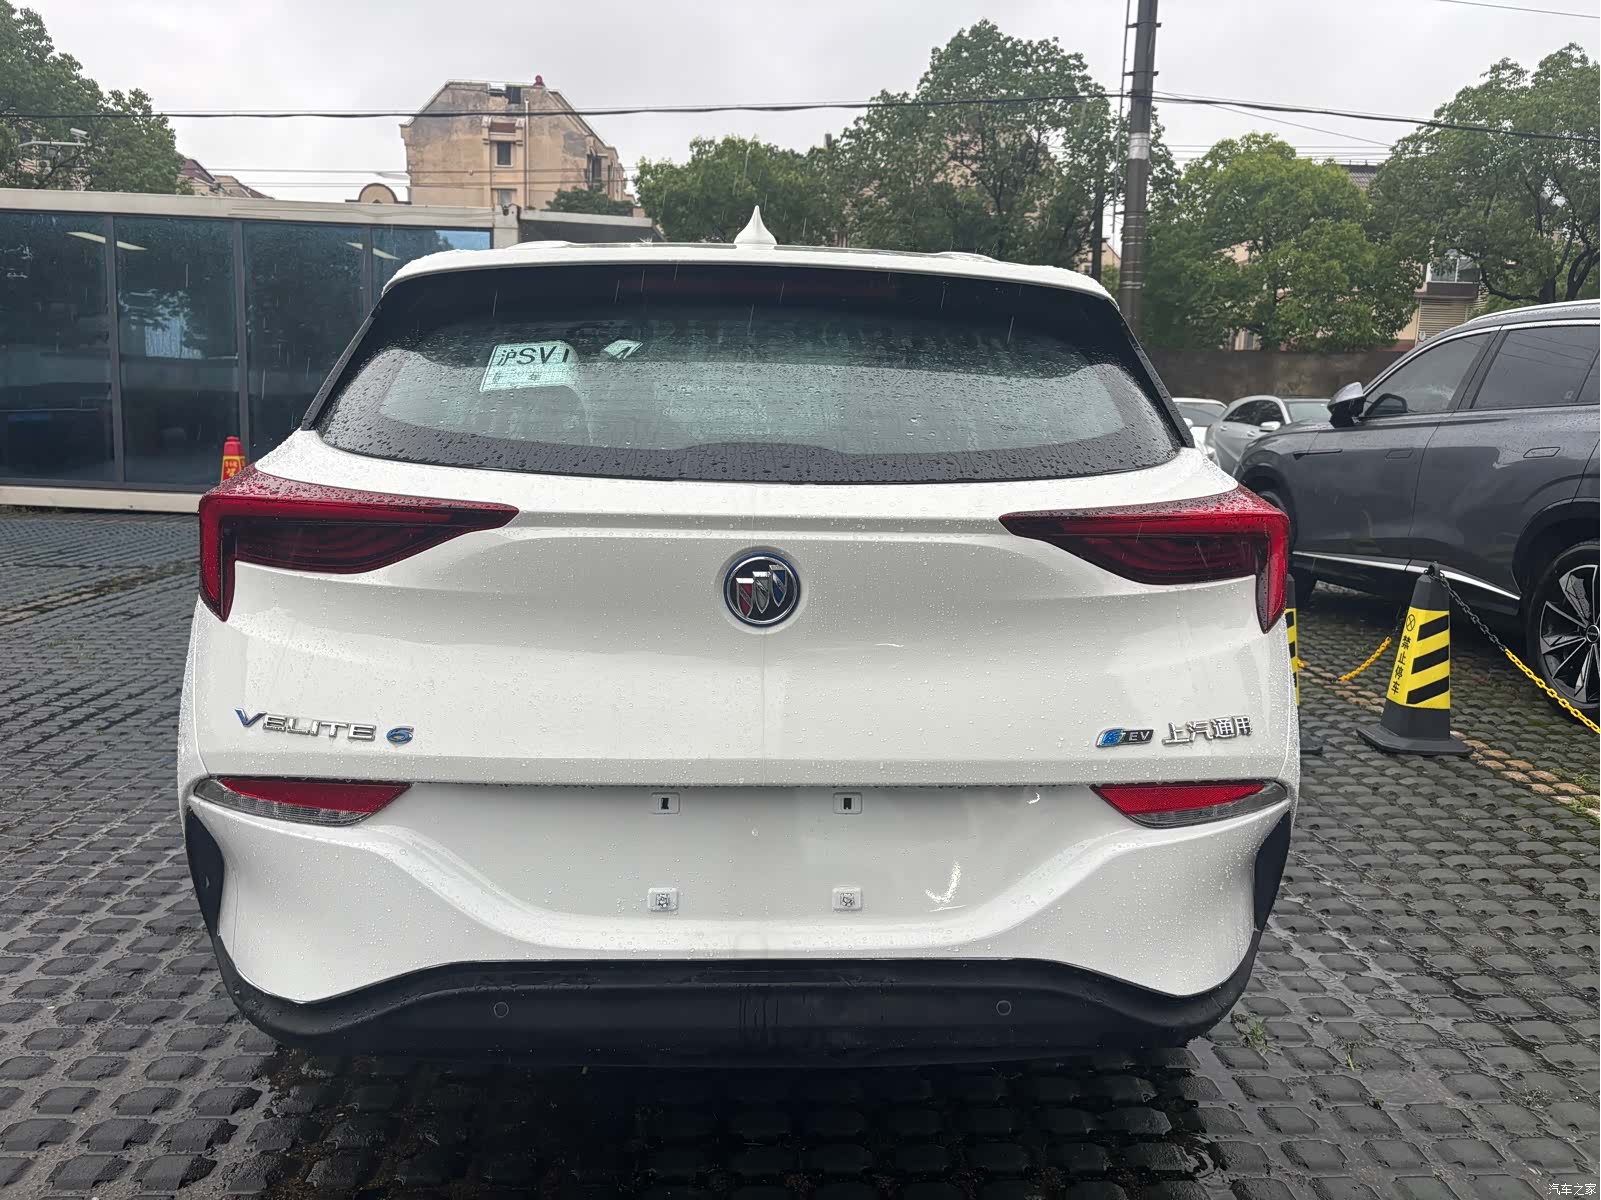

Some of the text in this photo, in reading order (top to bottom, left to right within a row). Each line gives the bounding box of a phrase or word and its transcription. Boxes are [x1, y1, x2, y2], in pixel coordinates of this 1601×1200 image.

[1391, 635, 1412, 695] 禁止停车
[234, 706, 415, 745] VELITE 6
[1161, 715, 1252, 745] 上汽通用
